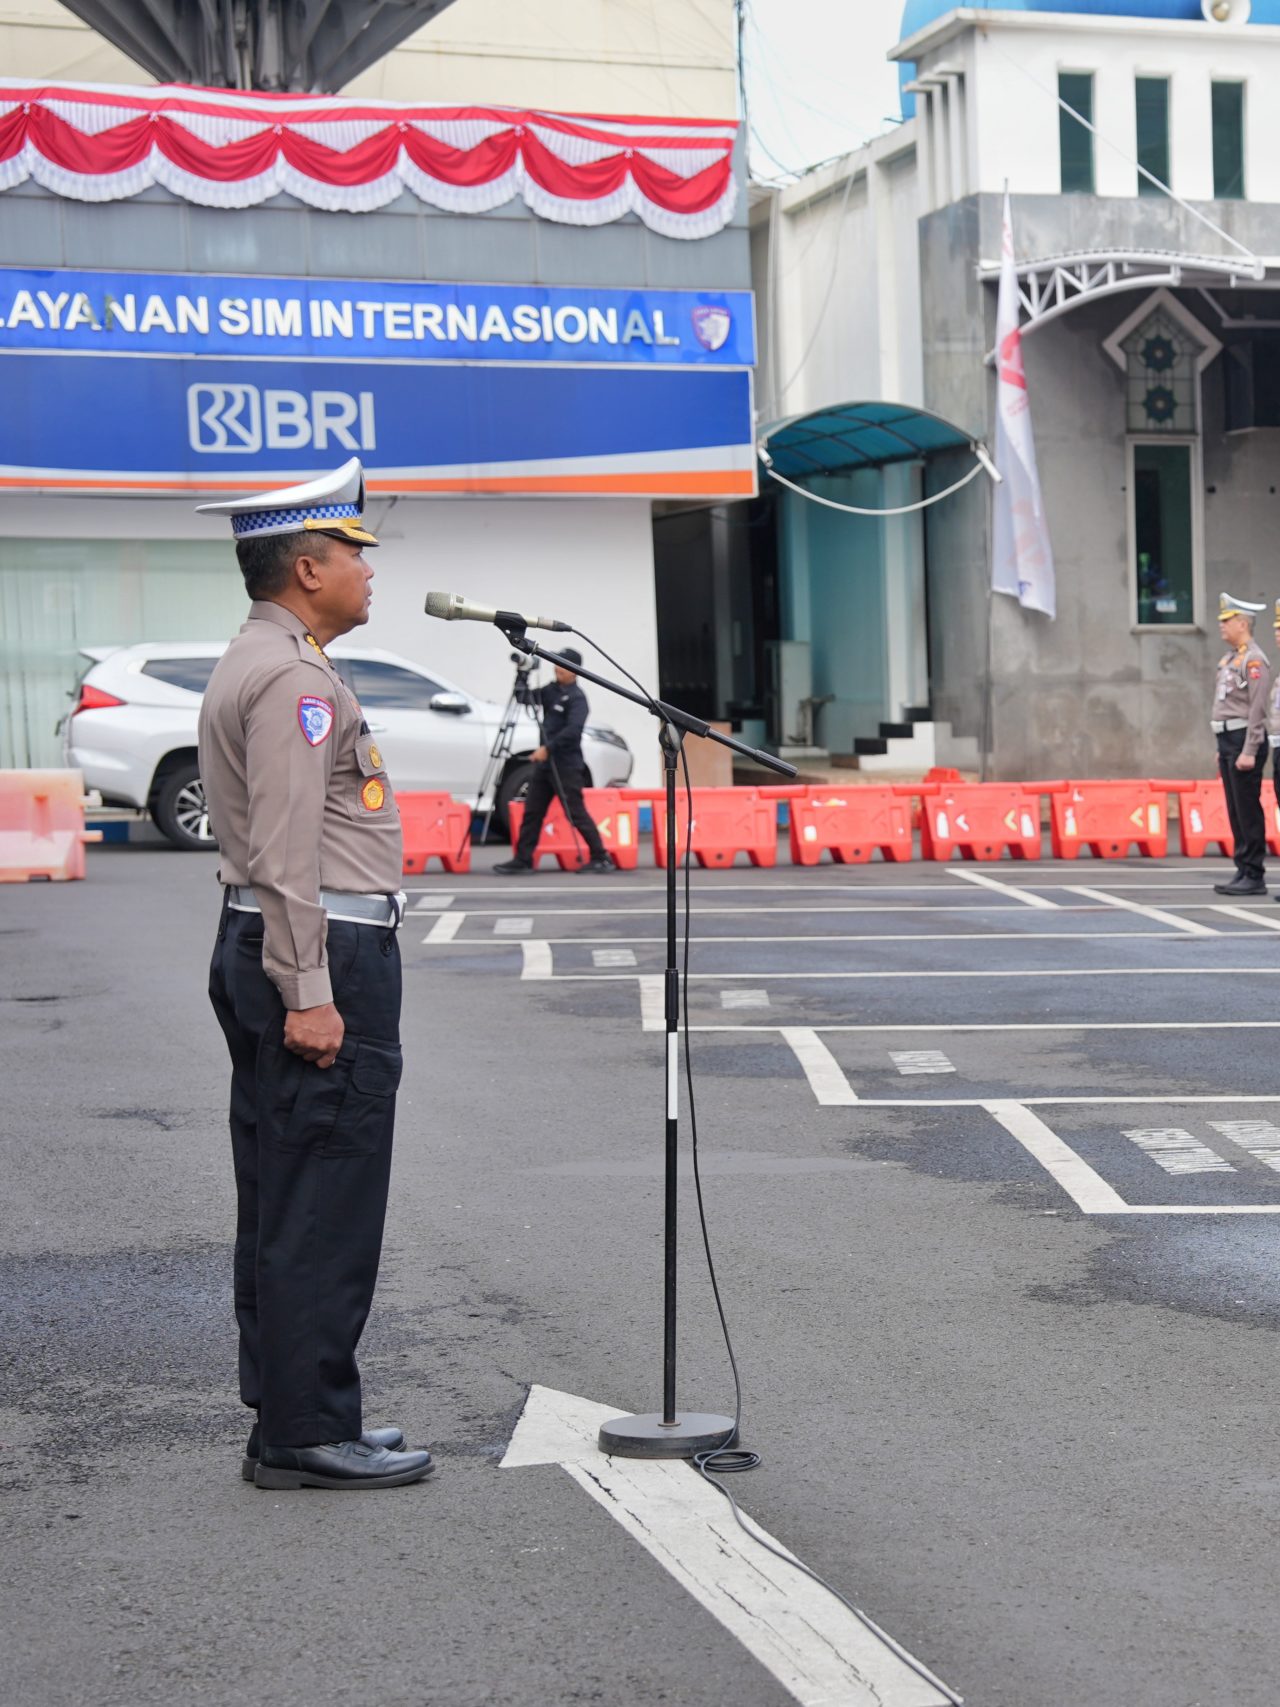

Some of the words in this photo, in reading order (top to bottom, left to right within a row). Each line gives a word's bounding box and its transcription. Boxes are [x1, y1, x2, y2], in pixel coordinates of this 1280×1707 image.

[0, 289, 209, 334] AYANAN
[218, 297, 303, 337] SIM
[309, 299, 680, 346] INTERNASIONAL
[263, 389, 376, 450] BRI
